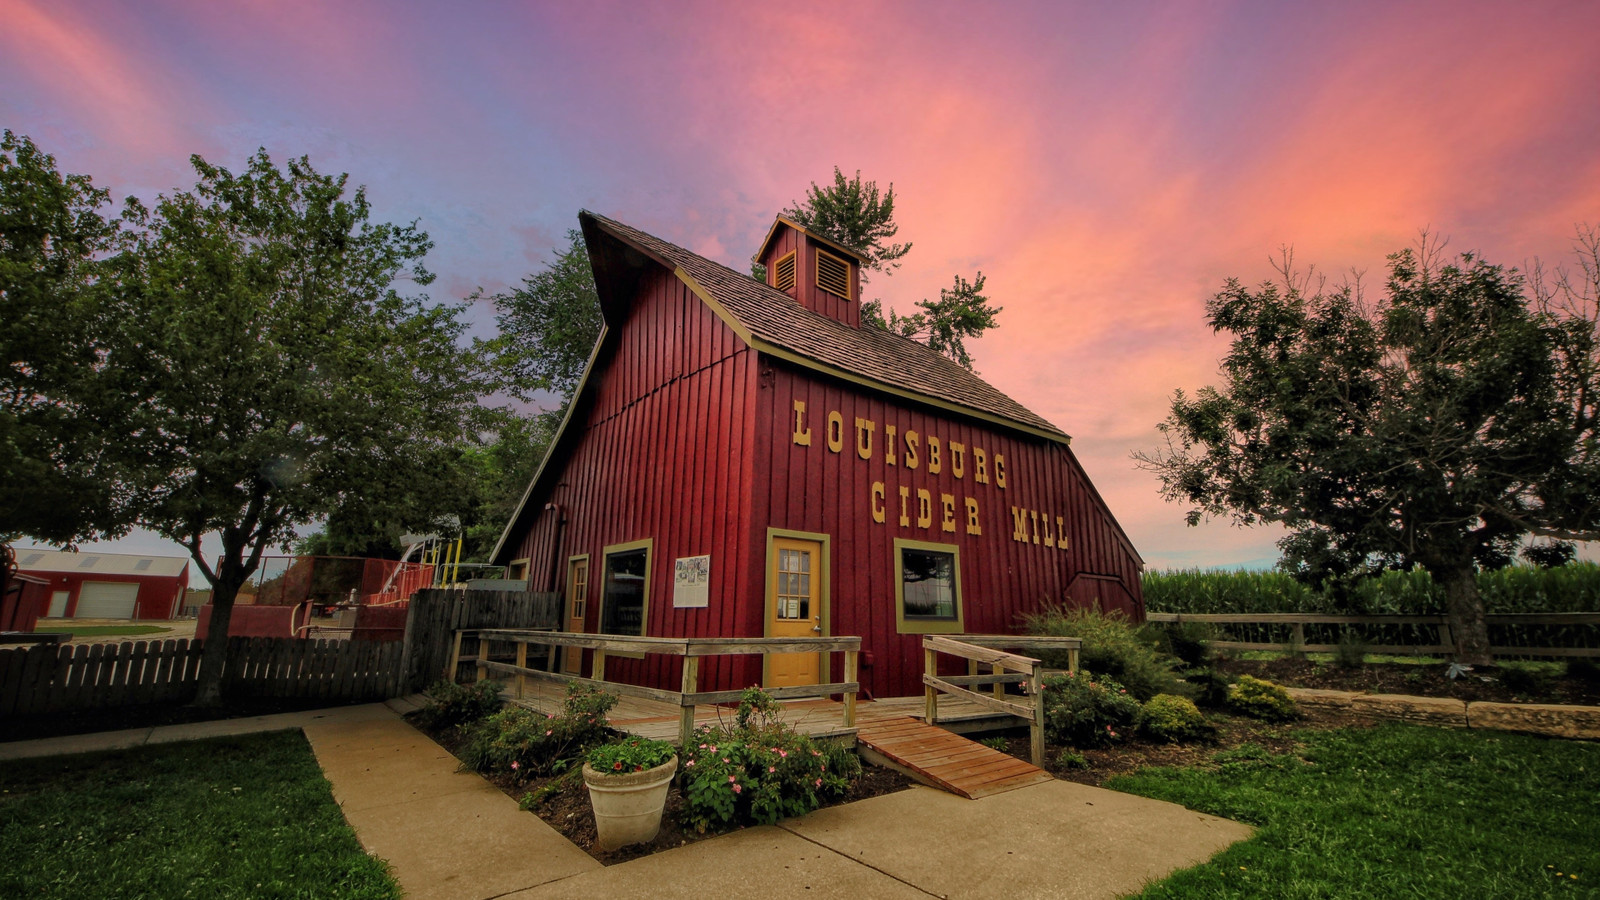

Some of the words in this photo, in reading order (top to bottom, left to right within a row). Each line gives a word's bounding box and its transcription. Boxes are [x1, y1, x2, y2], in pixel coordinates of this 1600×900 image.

[793, 400, 1007, 488] LOUISBURG
[871, 481, 982, 535] CIDER
[1011, 505, 1069, 549] MILL
